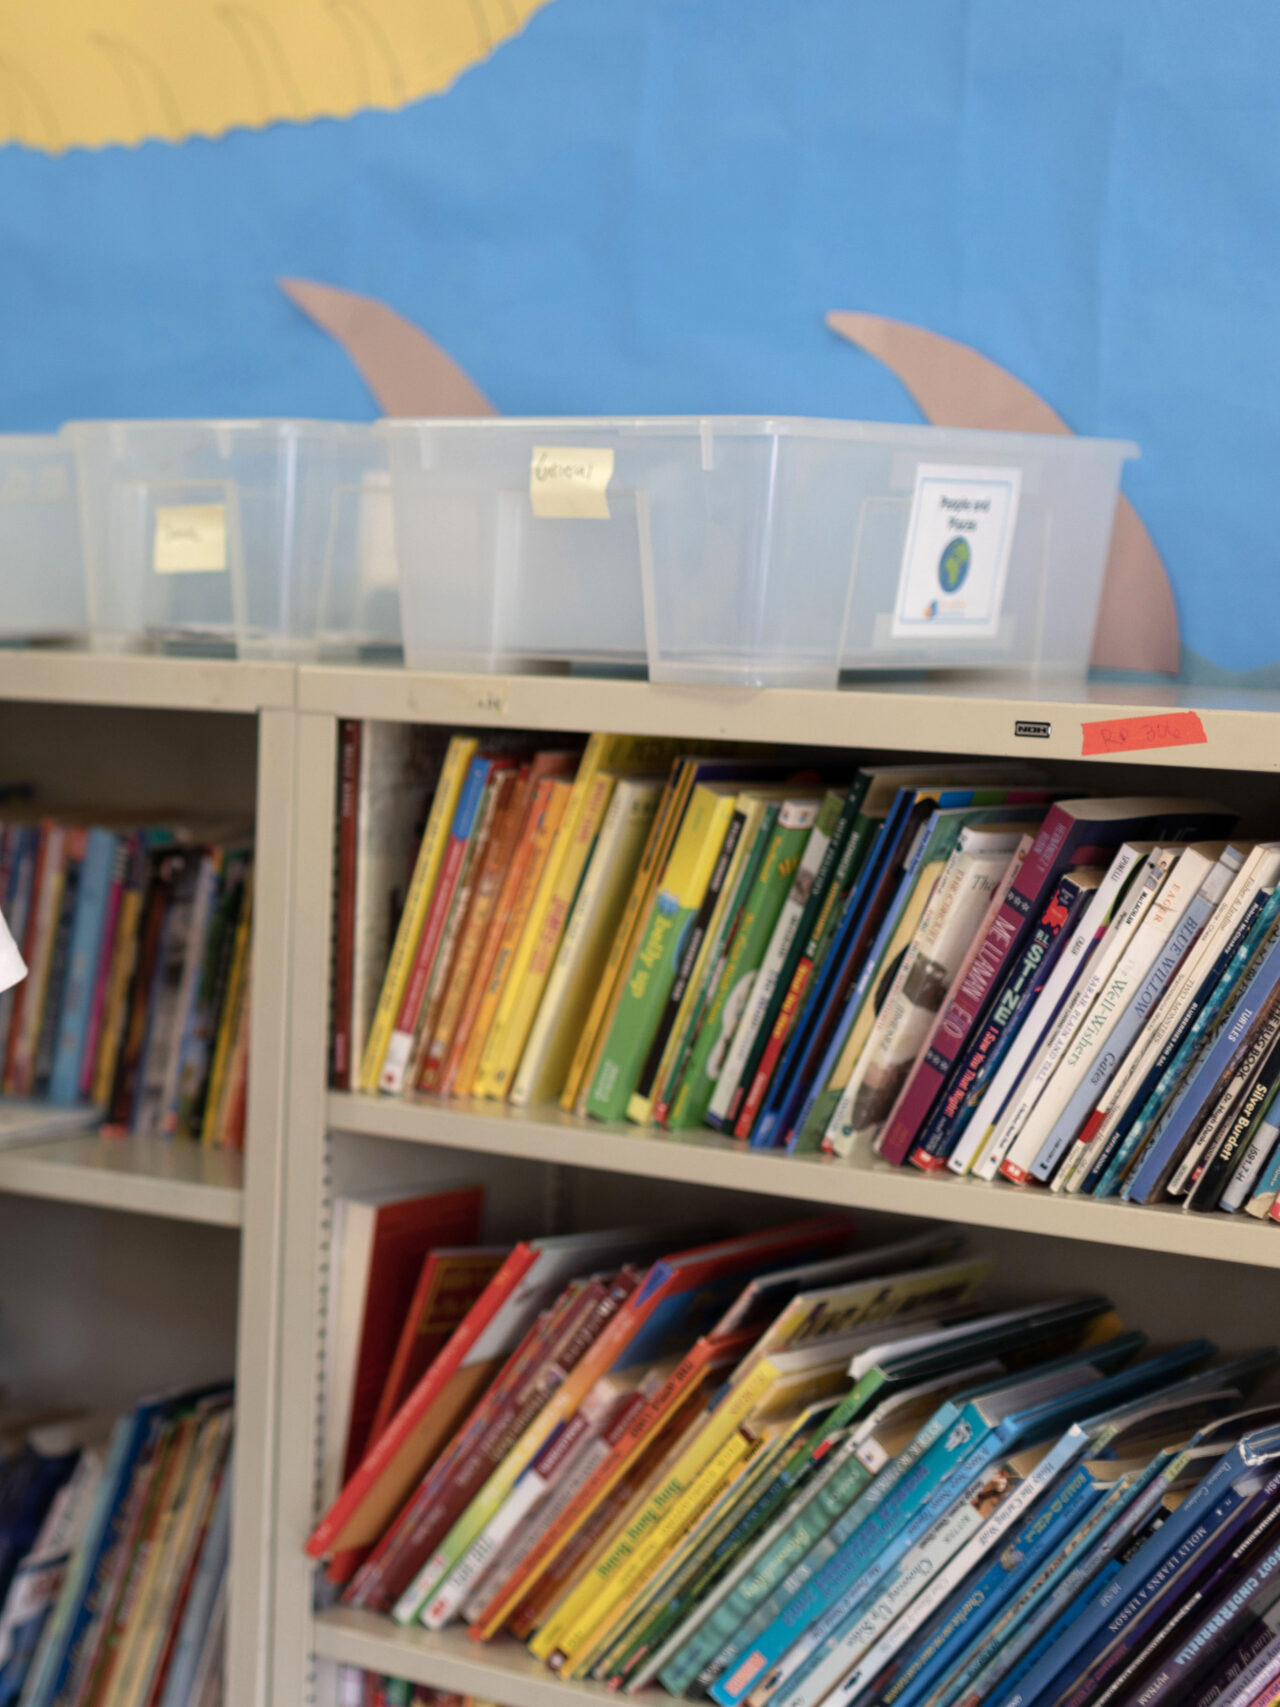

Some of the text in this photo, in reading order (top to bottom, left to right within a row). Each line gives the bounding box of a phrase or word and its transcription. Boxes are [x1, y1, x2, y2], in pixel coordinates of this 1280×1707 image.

[1152, 882, 1181, 923] EAGER
[1242, 901, 1259, 923] Robert
[986, 914, 1018, 947] ME
[626, 914, 673, 999] belly up
[989, 940, 1047, 1027] STINE
[1088, 915, 1199, 1088] BLUE WILLOW Gates
[1059, 1008, 1081, 1039] PLAIN
[1066, 975, 1128, 1070] Well-Wishers
[1152, 978, 1195, 1045] TWO MONSTERS
[1226, 1006, 1253, 1043] TURTLES
[977, 1030, 997, 1054] Saw
[1047, 1037, 1065, 1060] AND
[1154, 1000, 1198, 1068] BLUEBERRIES FOR SAL
[1235, 1022, 1275, 1081] BUG BOOK
[957, 1067, 976, 1091] That
[967, 1050, 985, 1071] You
[1208, 1103, 1225, 1125] Hugh
[1241, 1081, 1269, 1118] Silver
[1195, 1123, 1213, 1147] Danks
[1217, 1114, 1250, 1162] Burdett
[1106, 1524, 1207, 1634] MOLLY LEARNS A LESSON
